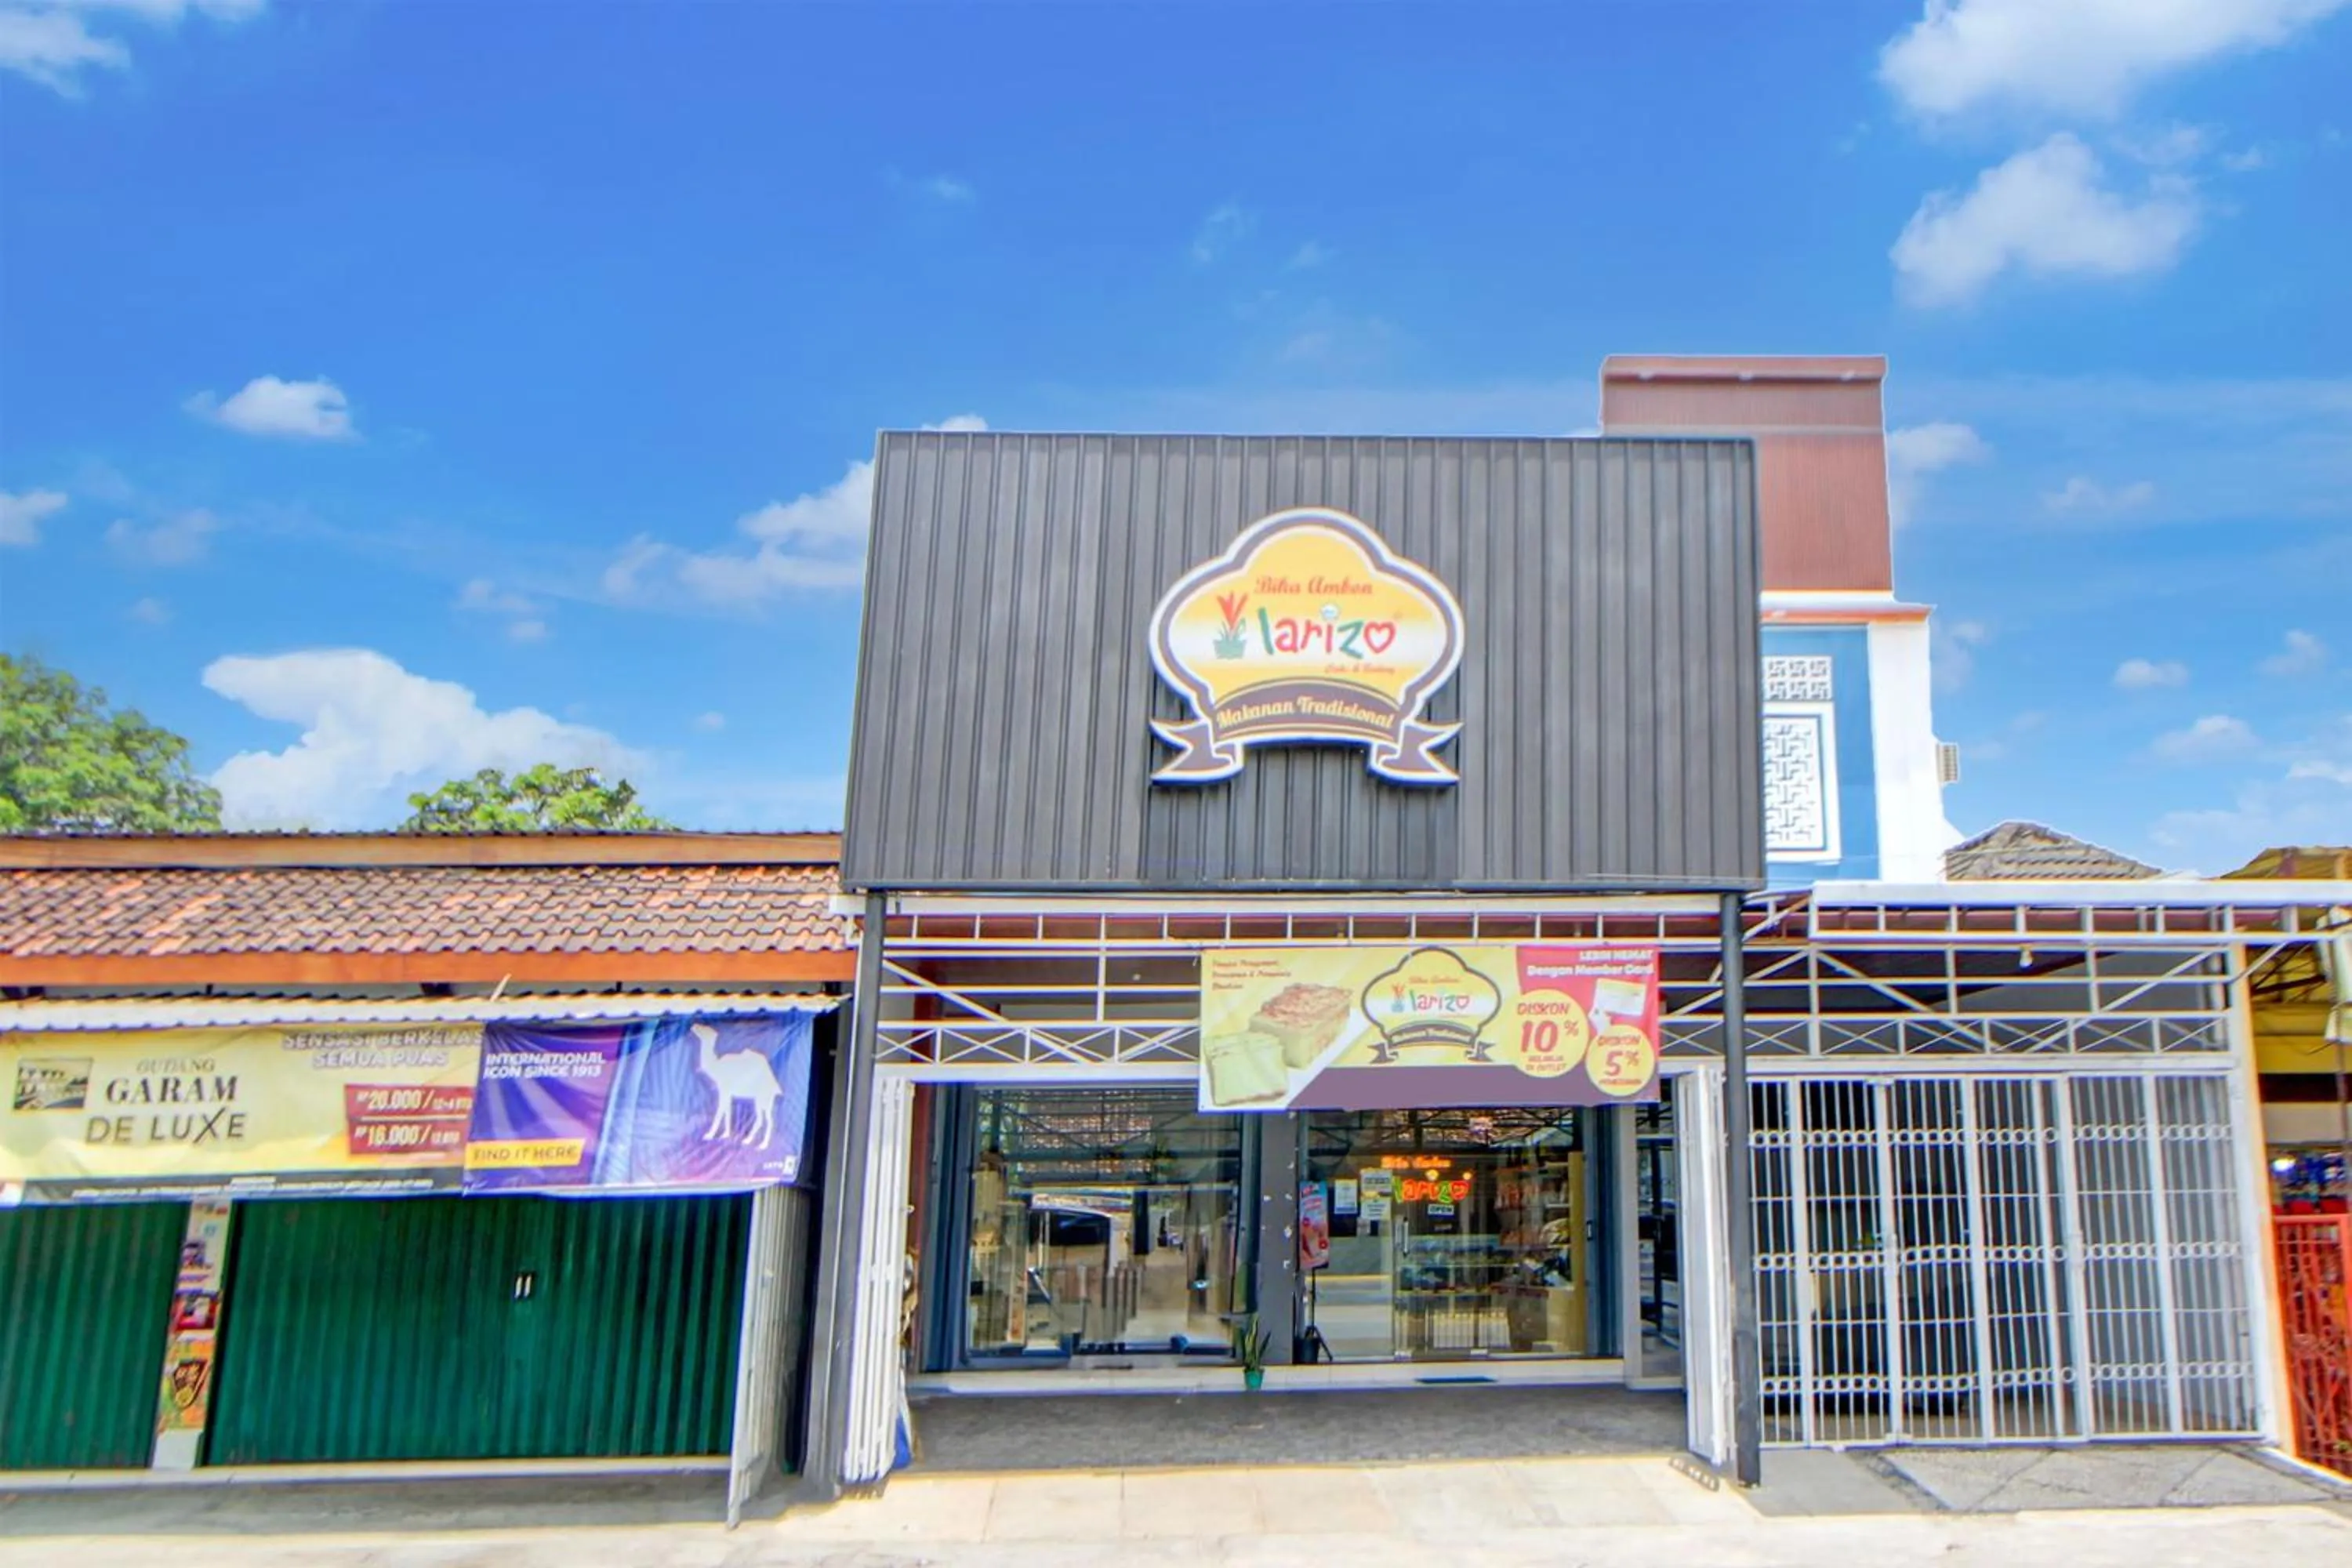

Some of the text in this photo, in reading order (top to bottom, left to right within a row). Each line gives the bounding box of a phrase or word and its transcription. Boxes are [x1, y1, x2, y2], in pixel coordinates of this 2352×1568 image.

[1308, 575, 1373, 595] Ambon
[1258, 603, 1396, 659] larizo
[1217, 695, 1396, 729] Makanan Tradisional
[1527, 963, 1654, 978] Dengan Member Card
[1517, 1003, 1570, 1015] DISKON
[376, 1029, 483, 1047] BERKELAS
[1598, 1035, 1642, 1047] DISKON
[314, 1049, 449, 1068] SEMUA PUAS
[485, 1051, 606, 1065] INTERNATIONAL
[482, 1064, 602, 1080] ICON SINCE 1913
[105, 1075, 238, 1105] GARAM
[85, 1106, 248, 1145] DE LUXE
[473, 1145, 578, 1161] FIND IT HERE
[1429, 1205, 1453, 1214] OPEN
